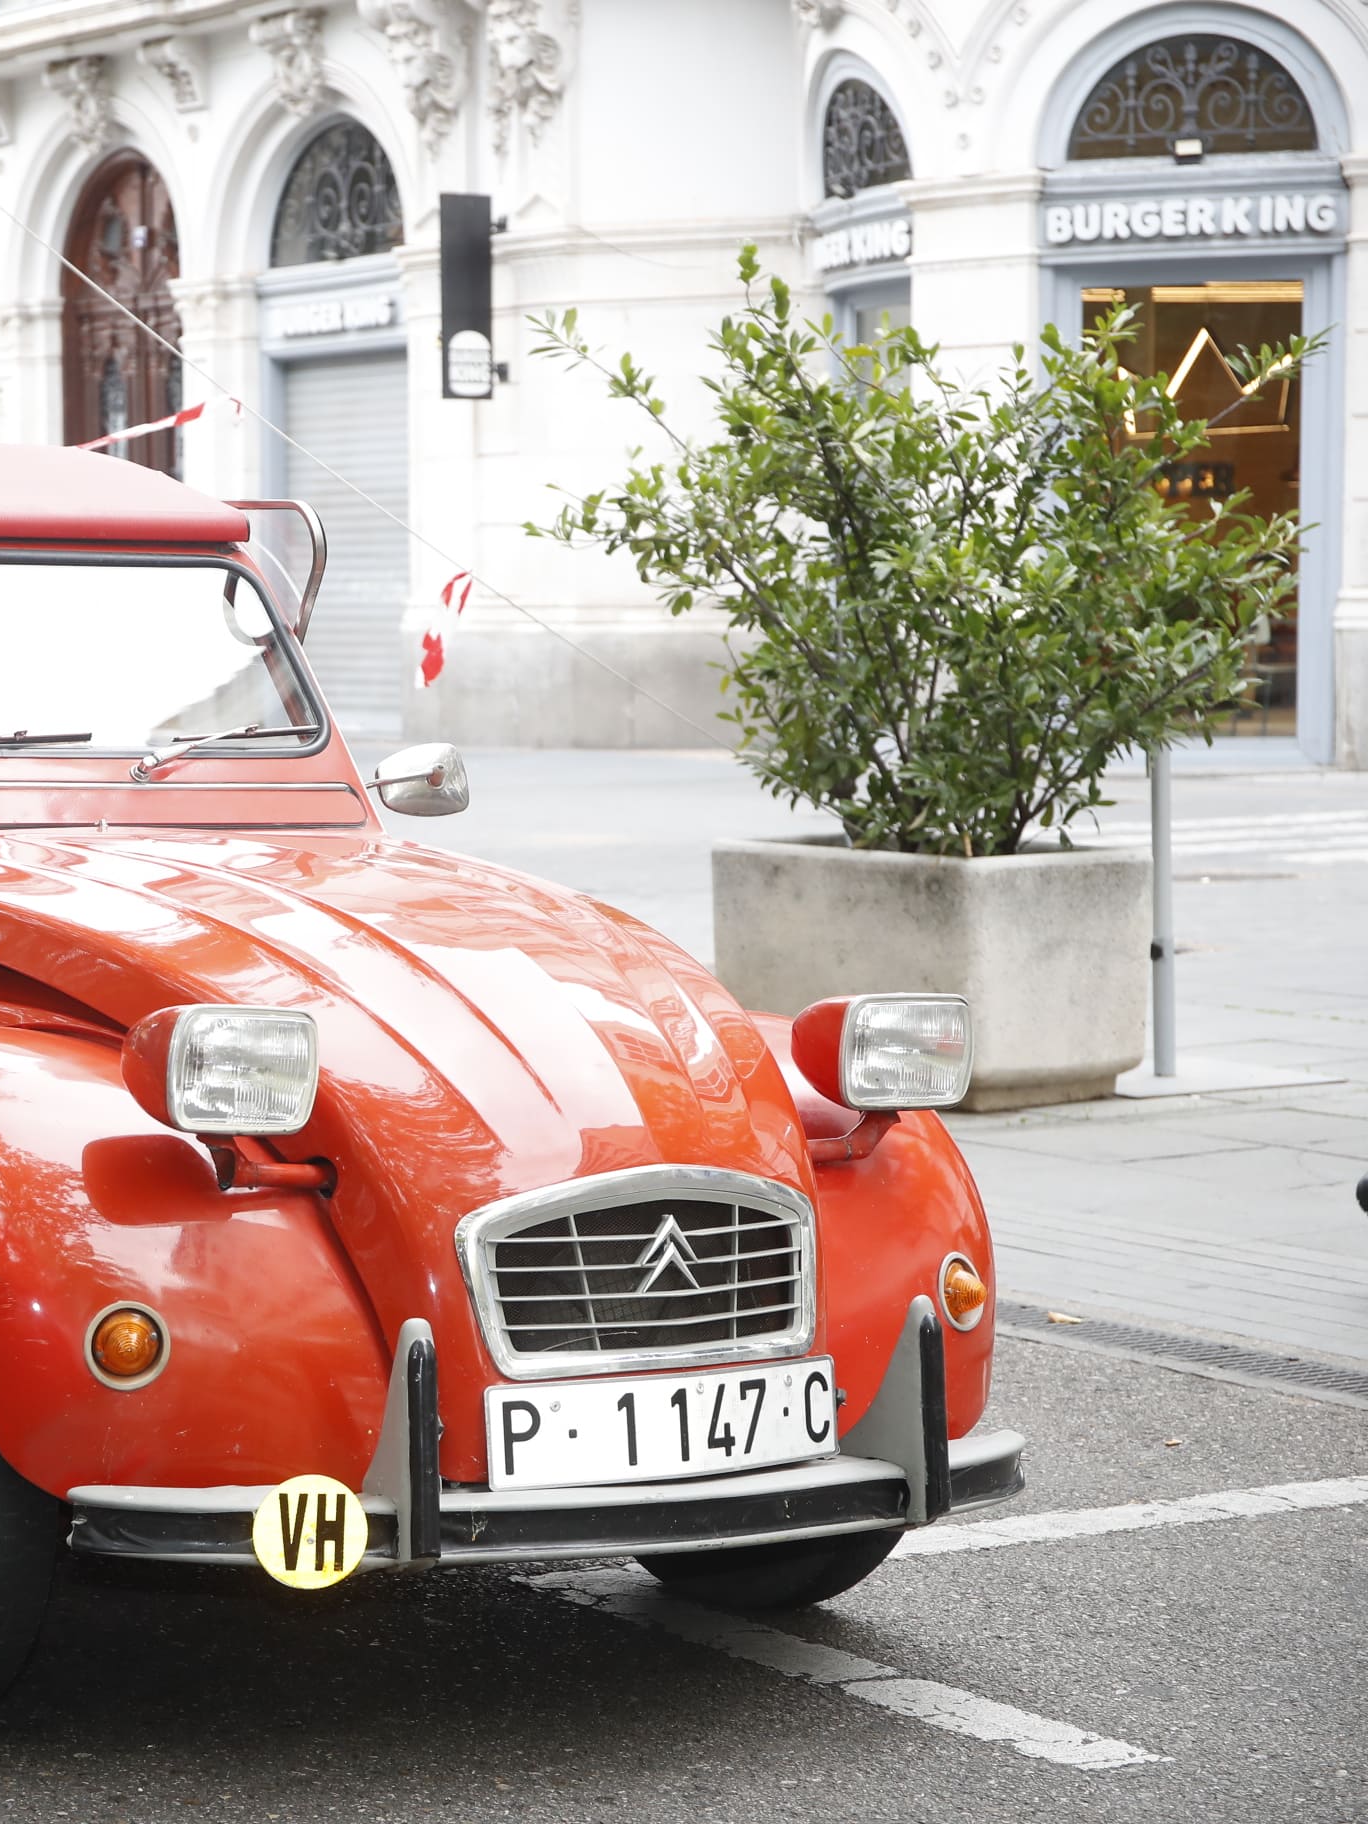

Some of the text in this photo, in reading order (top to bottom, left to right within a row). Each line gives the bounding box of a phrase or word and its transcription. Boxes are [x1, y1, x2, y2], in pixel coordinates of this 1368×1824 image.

[1045, 194, 1337, 244] BURGER KING
[278, 1493, 346, 1571] VH
